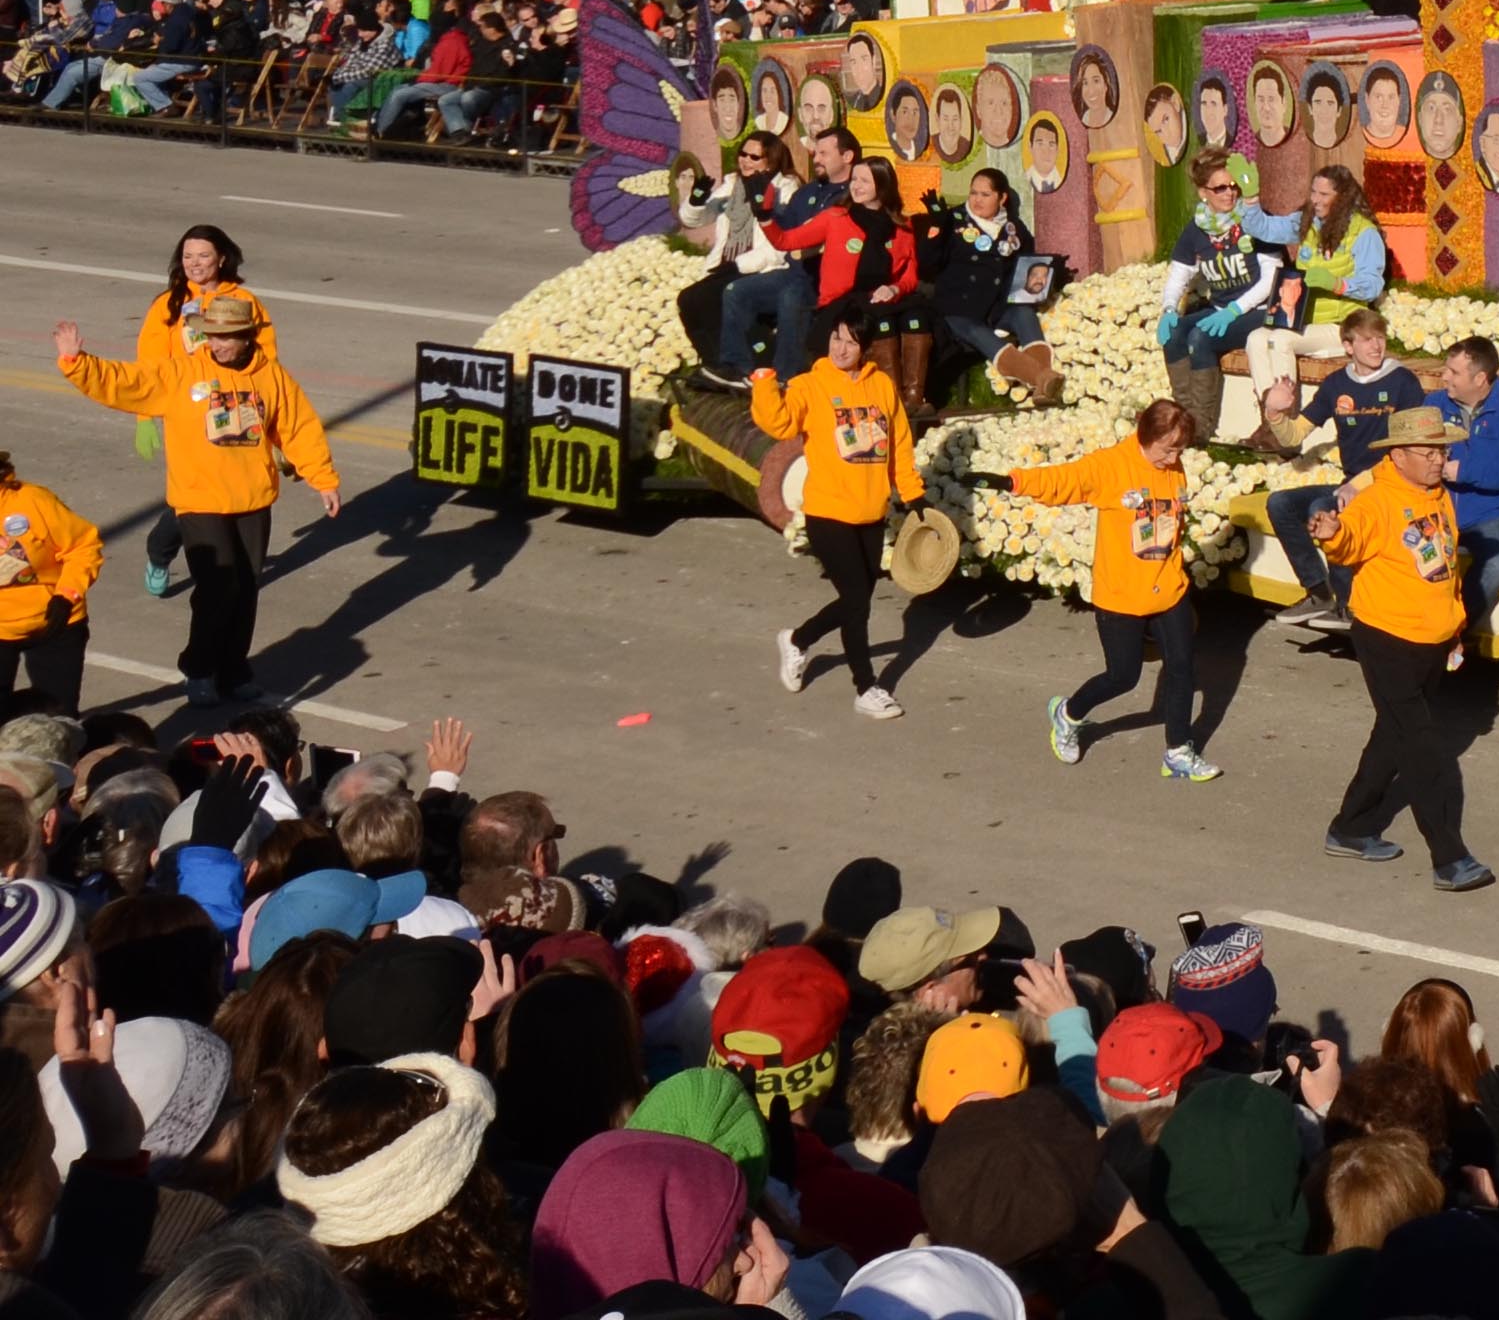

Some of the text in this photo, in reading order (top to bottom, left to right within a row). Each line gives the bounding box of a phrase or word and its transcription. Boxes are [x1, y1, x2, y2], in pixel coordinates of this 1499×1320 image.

[422, 355, 505, 394] DONATE
[537, 369, 616, 409] DONE
[421, 415, 503, 480] LIFE
[532, 436, 614, 499] VIDA
